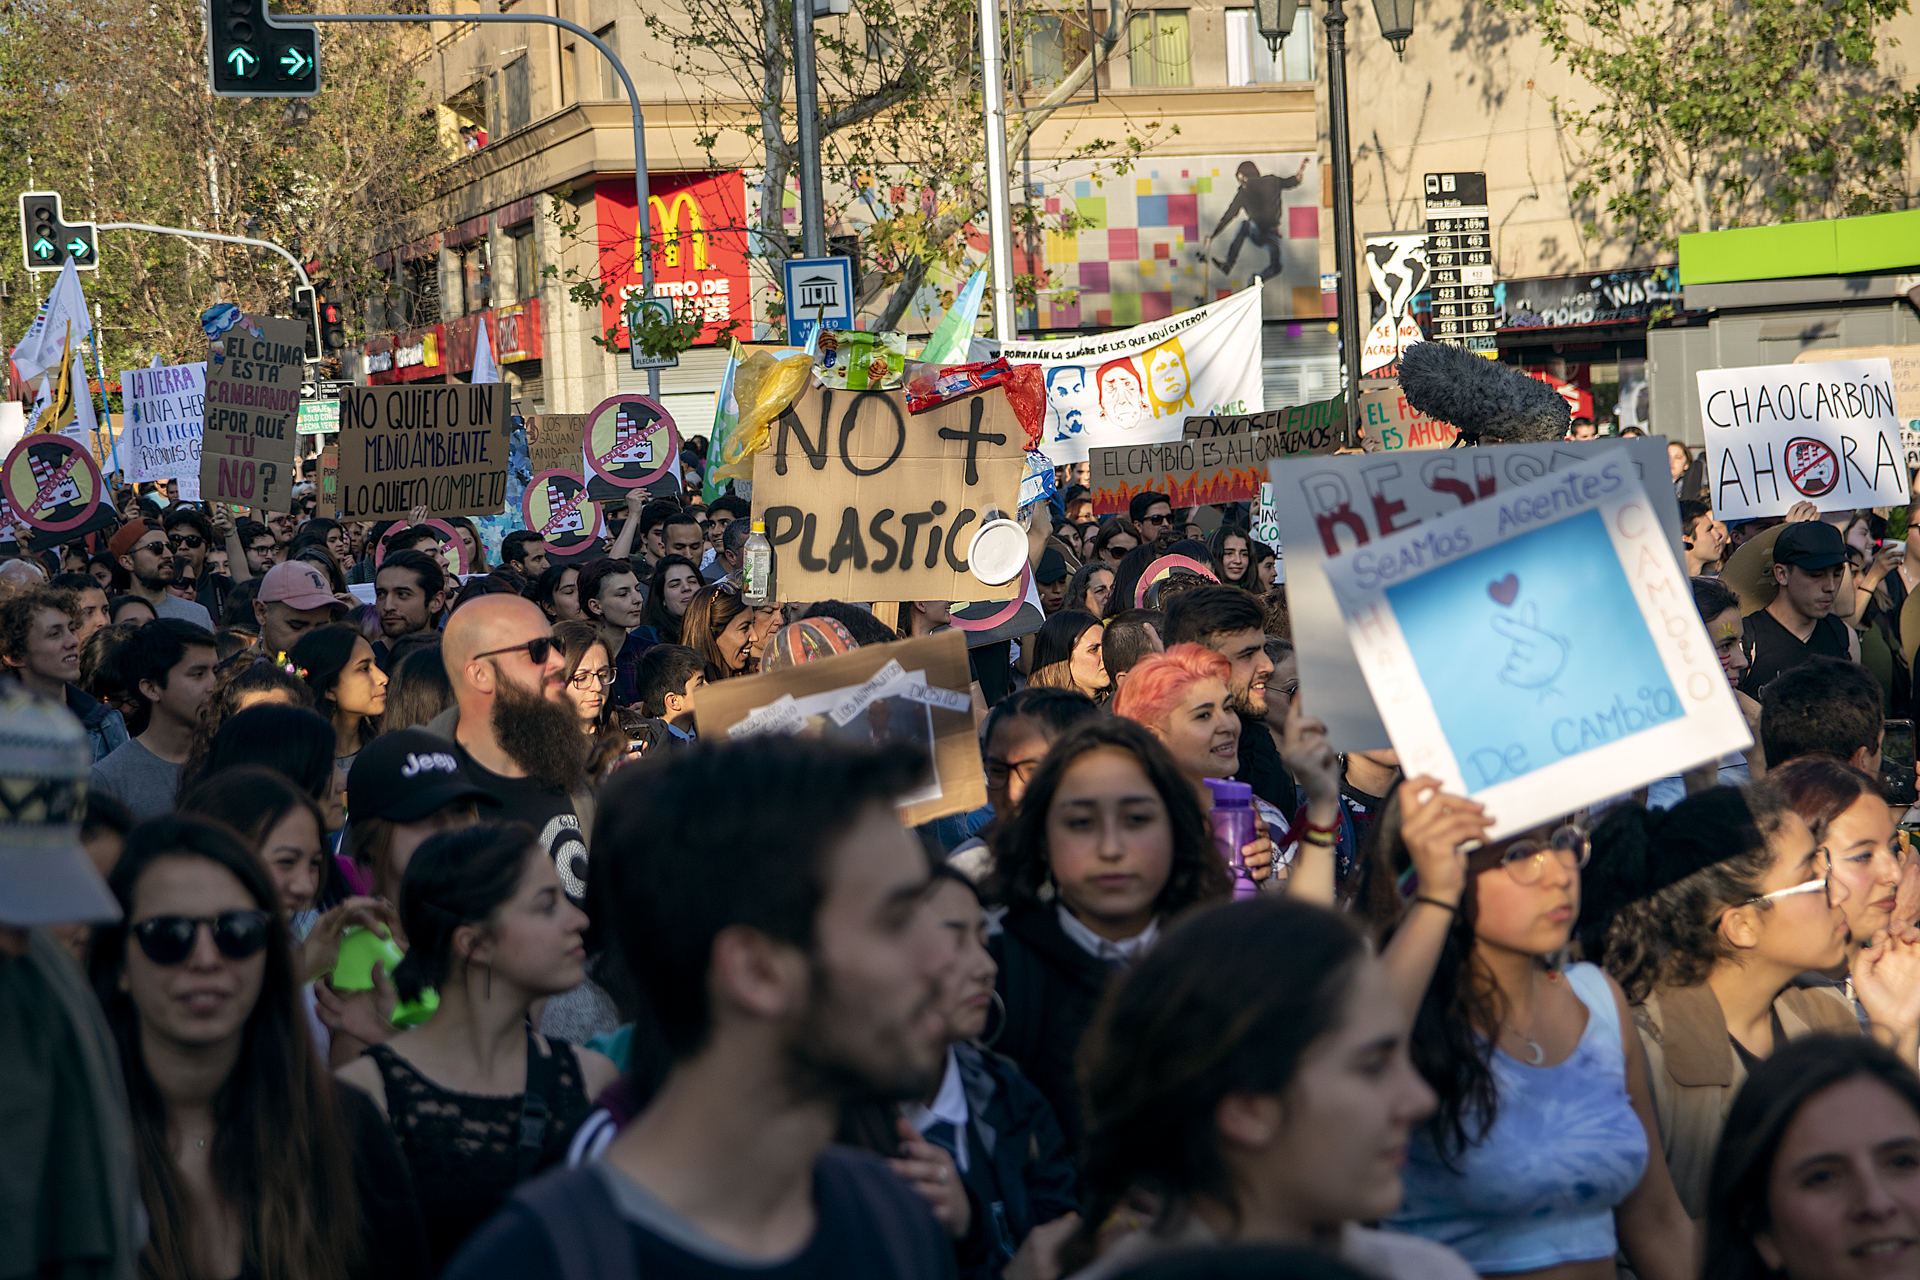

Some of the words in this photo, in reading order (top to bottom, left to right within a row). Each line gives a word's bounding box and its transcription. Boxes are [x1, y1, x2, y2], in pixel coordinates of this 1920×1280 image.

[1435, 220, 1451, 231] 106
[1464, 219, 1485, 230] 109n
[1436, 236, 1452, 247] 401
[1468, 236, 1484, 246] 403
[1437, 254, 1453, 264] 407
[1468, 252, 1485, 263] 419
[1438, 271, 1454, 281] 421
[702, 279, 730, 295] DE
[1439, 288, 1456, 299] 423
[1468, 286, 1490, 297] 432n
[1440, 305, 1456, 316] 481
[1472, 303, 1488, 314] 513
[1376, 326, 1390, 339] SE
[1400, 326, 1420, 338] NOS
[1441, 322, 1458, 333] 516
[1472, 320, 1489, 331] 519
[226, 337, 248, 359] EL
[253, 342, 302, 367] CLIMA
[1098, 344, 1109, 354] DE
[1110, 340, 1127, 351] LXS
[1128, 336, 1146, 348] QUE
[232, 360, 284, 383] ESTÁ
[132, 372, 144, 399] LA
[147, 366, 196, 396] TIERRA
[207, 380, 300, 413] CAMBIANDO
[143, 399, 176, 424] UNA
[348, 388, 378, 429] NO
[469, 384, 493, 426] UN
[1367, 402, 1390, 426] EL
[256, 413, 290, 440] QUÉ
[303, 414, 319, 422] SOLO
[321, 413, 333, 422] CON
[543, 417, 561, 432] LOS
[133, 427, 143, 447] ES
[147, 427, 165, 445] UN
[539, 432, 575, 445] SALVAN
[776, 390, 906, 476] NO
[1382, 427, 1403, 451] ES
[226, 432, 256, 457] TÚ
[600, 424, 662, 464] #CHAOCARBON
[1104, 451, 1125, 477] EL
[1127, 445, 1195, 475] CAMBIO
[1203, 442, 1222, 468] ES
[1226, 432, 1281, 466] AHORA
[30, 457, 77, 514] #CHAOCARBON
[344, 485, 369, 516] LO
[431, 470, 507, 512] COMPLETO
[541, 493, 586, 536] #CHAOCARBON
[910, 684, 959, 707] DIOSITO
[401, 752, 458, 779] Jeep
